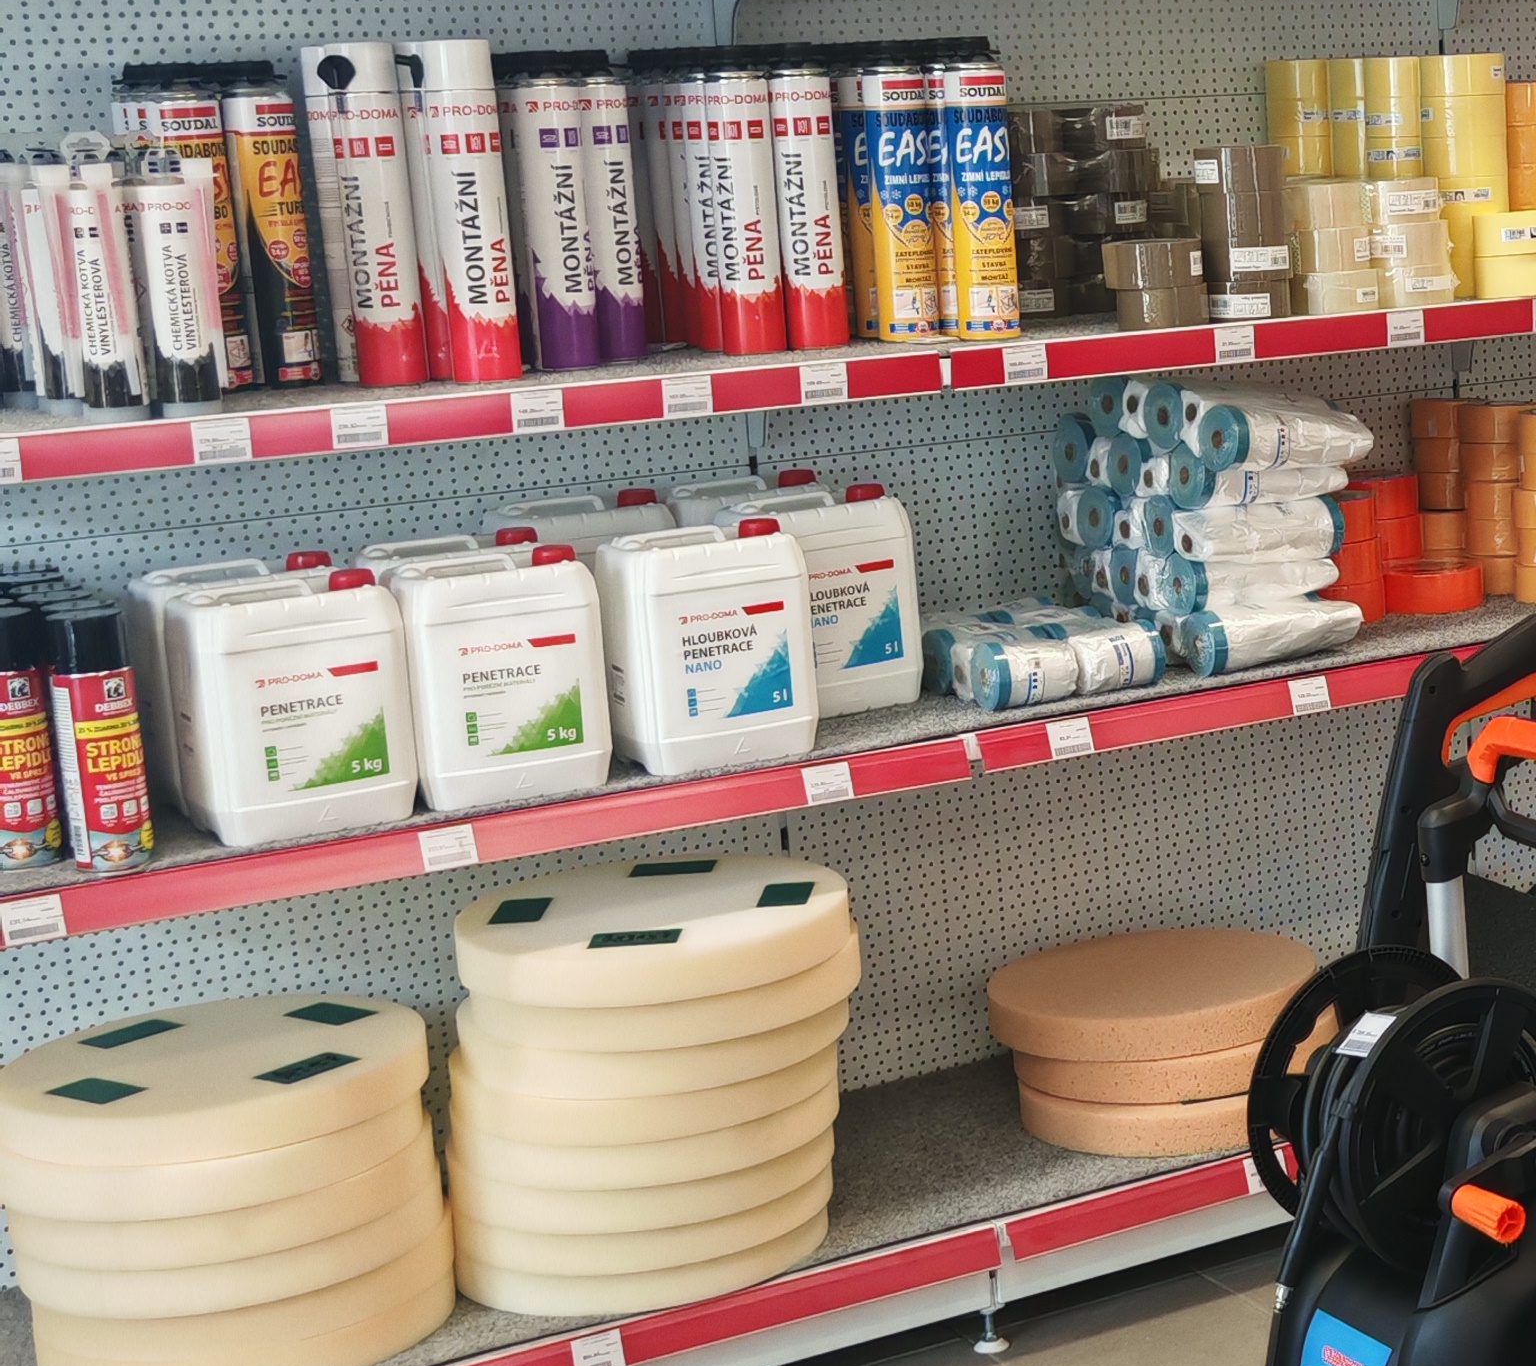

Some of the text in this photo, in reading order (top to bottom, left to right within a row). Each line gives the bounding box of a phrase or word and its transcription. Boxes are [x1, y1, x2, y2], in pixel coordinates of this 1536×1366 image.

[708, 93, 767, 105] PRO-DOMA
[340, 175, 375, 309] MONTÁŽNÍ
[450, 170, 489, 305] MONTÁŽNÍ
[550, 164, 583, 295] MONTÁŽNÍ
[603, 160, 635, 287] MONTÁŽNÍ
[713, 155, 741, 281] MONTÁŽNÍ
[780, 152, 812, 277] MONTÁŽNÍ
[812, 213, 835, 275] PĚNA
[374, 241, 401, 309] PĚNA
[489, 237, 511, 304] PĚNA
[742, 218, 765, 281] PĚNA
[76, 249, 98, 356] CHEMICKÁ KOTVA
[88, 257, 112, 356] VINYLESTEROVÁ
[161, 244, 183, 351] CHEMICKÁ KOTVA
[175, 252, 198, 351] VINYLESTEROVÁ
[810, 580, 870, 602] LOUBKOVÁ
[810, 596, 867, 616] ENETRACE
[682, 623, 758, 647] HLOUBKOVÁ
[683, 640, 754, 661] PENETRACE
[885, 642, 893, 655] 5
[462, 663, 542, 685] PENETRACE
[685, 659, 722, 675] NANO
[772, 691, 782, 704] 5
[260, 693, 344, 718] PENETRACE
[547, 726, 577, 741] 5 kg
[351, 757, 382, 773] 5 kg
